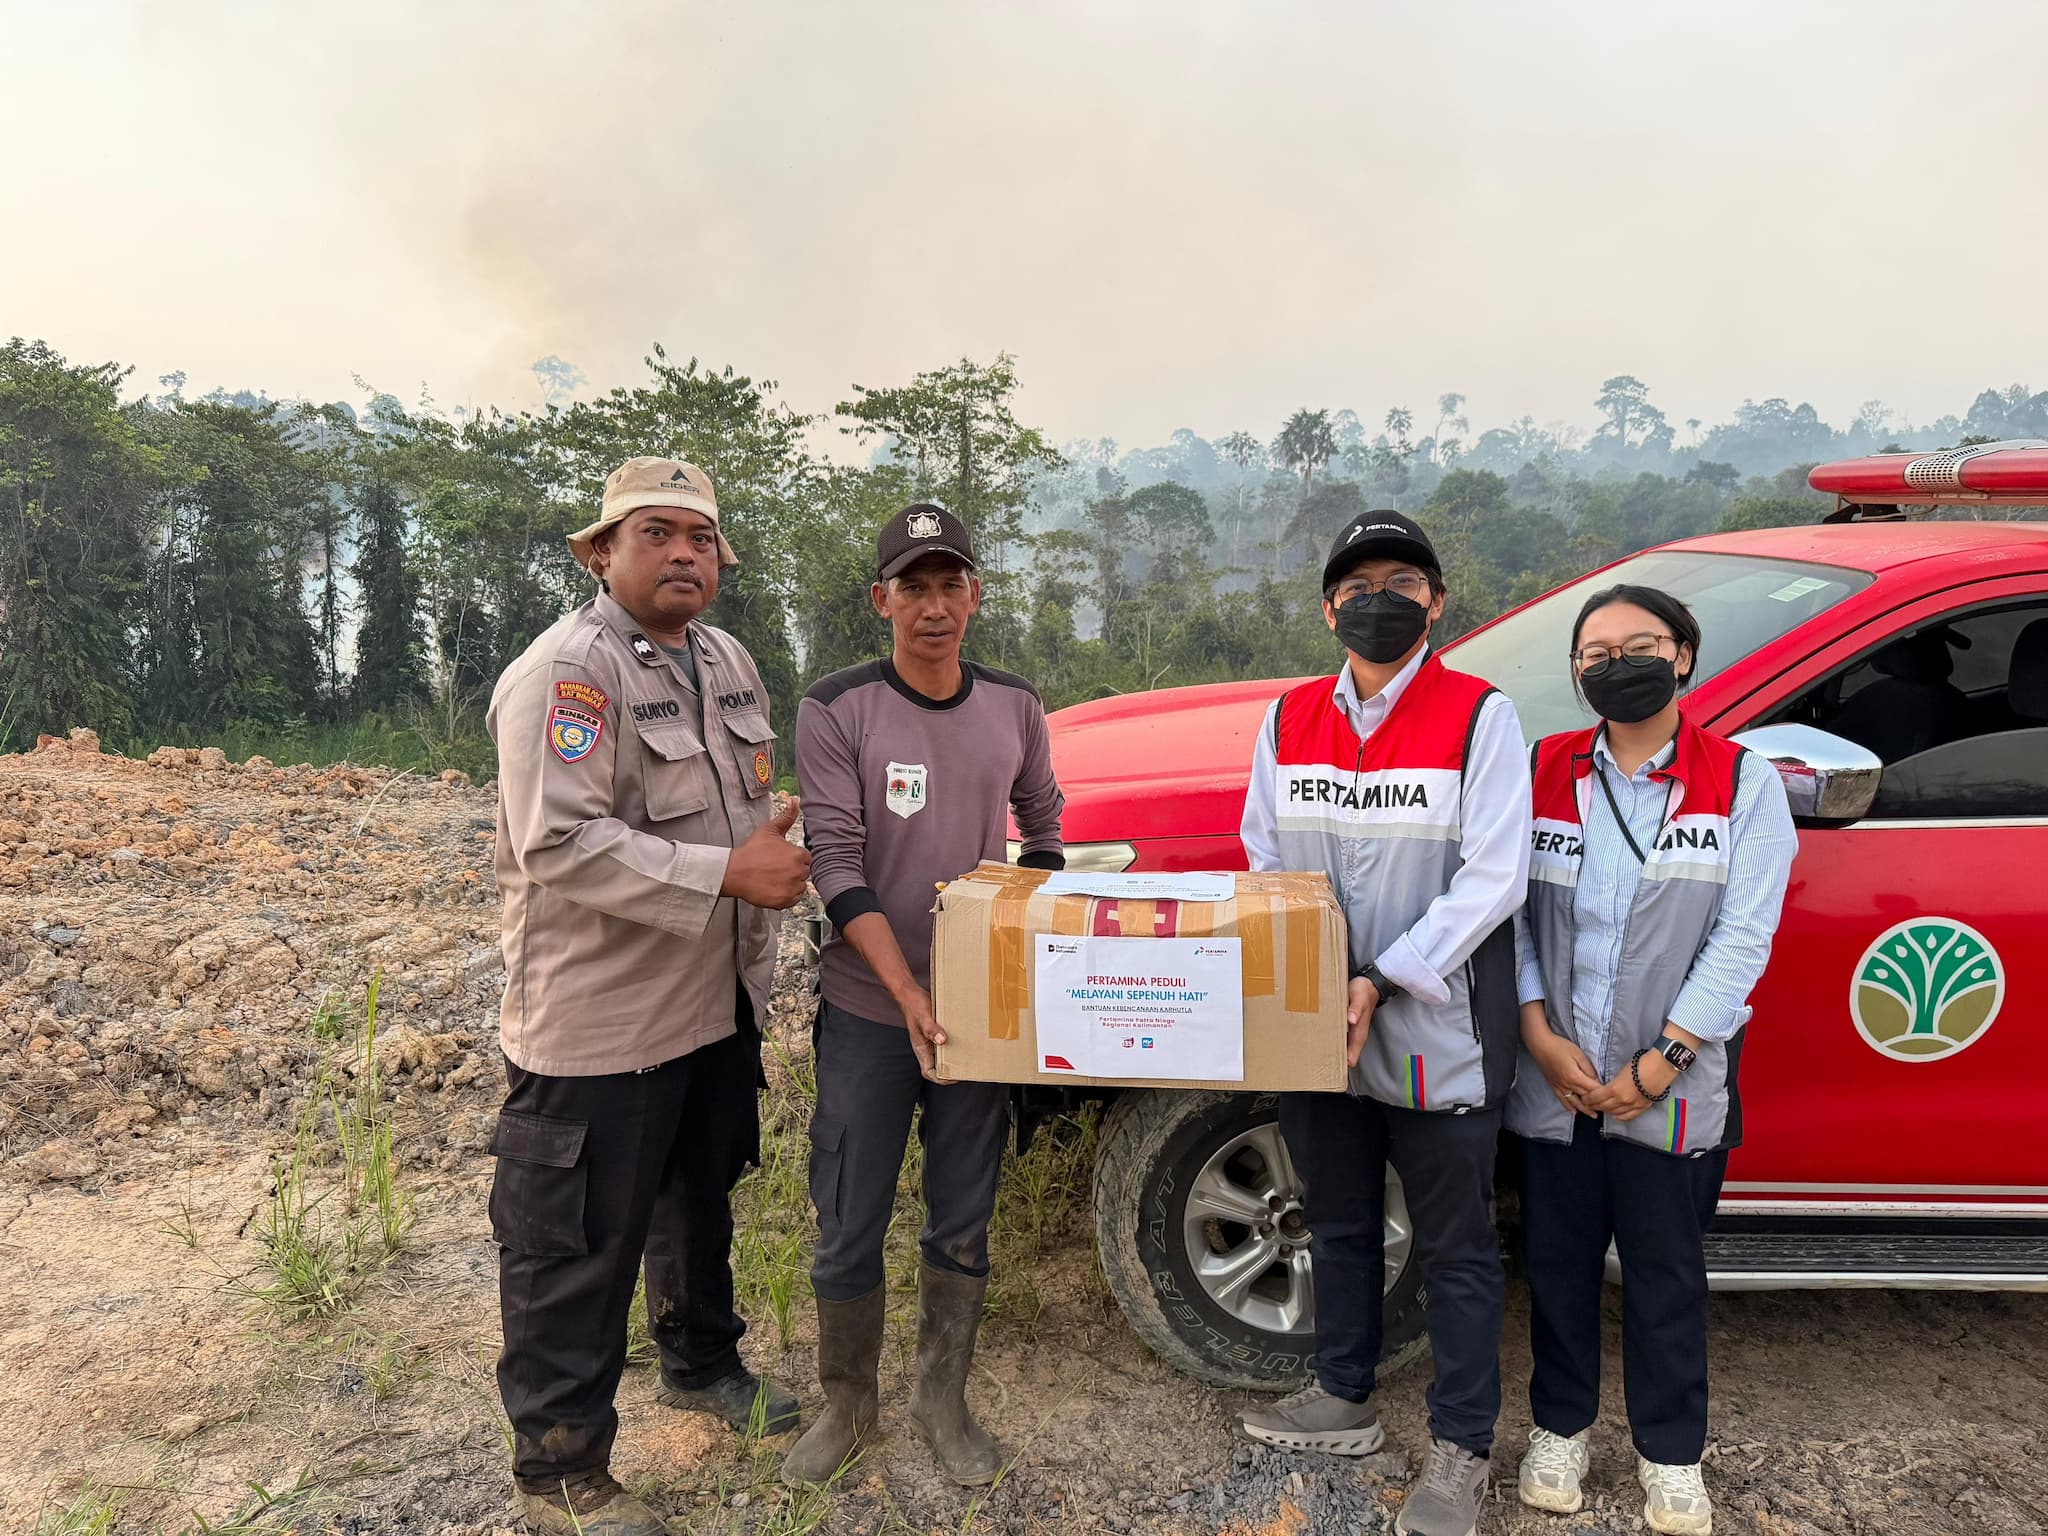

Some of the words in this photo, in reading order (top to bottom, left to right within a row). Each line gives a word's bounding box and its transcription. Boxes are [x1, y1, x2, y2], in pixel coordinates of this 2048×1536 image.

[660, 482, 700, 495] EIGER
[1366, 523, 1408, 535] PERTAMINA
[718, 689, 758, 711] POLRI
[632, 699, 680, 721] SURYO
[557, 709, 598, 727] BINMAS
[1289, 778, 1429, 810] PERTAMINA
[1087, 975, 1147, 987] PERTAMINA
[1150, 977, 1186, 988] PEDULI
[1127, 990, 1175, 1001] SEPENUH
[1112, 1005, 1159, 1013] KEBENCANAAN
